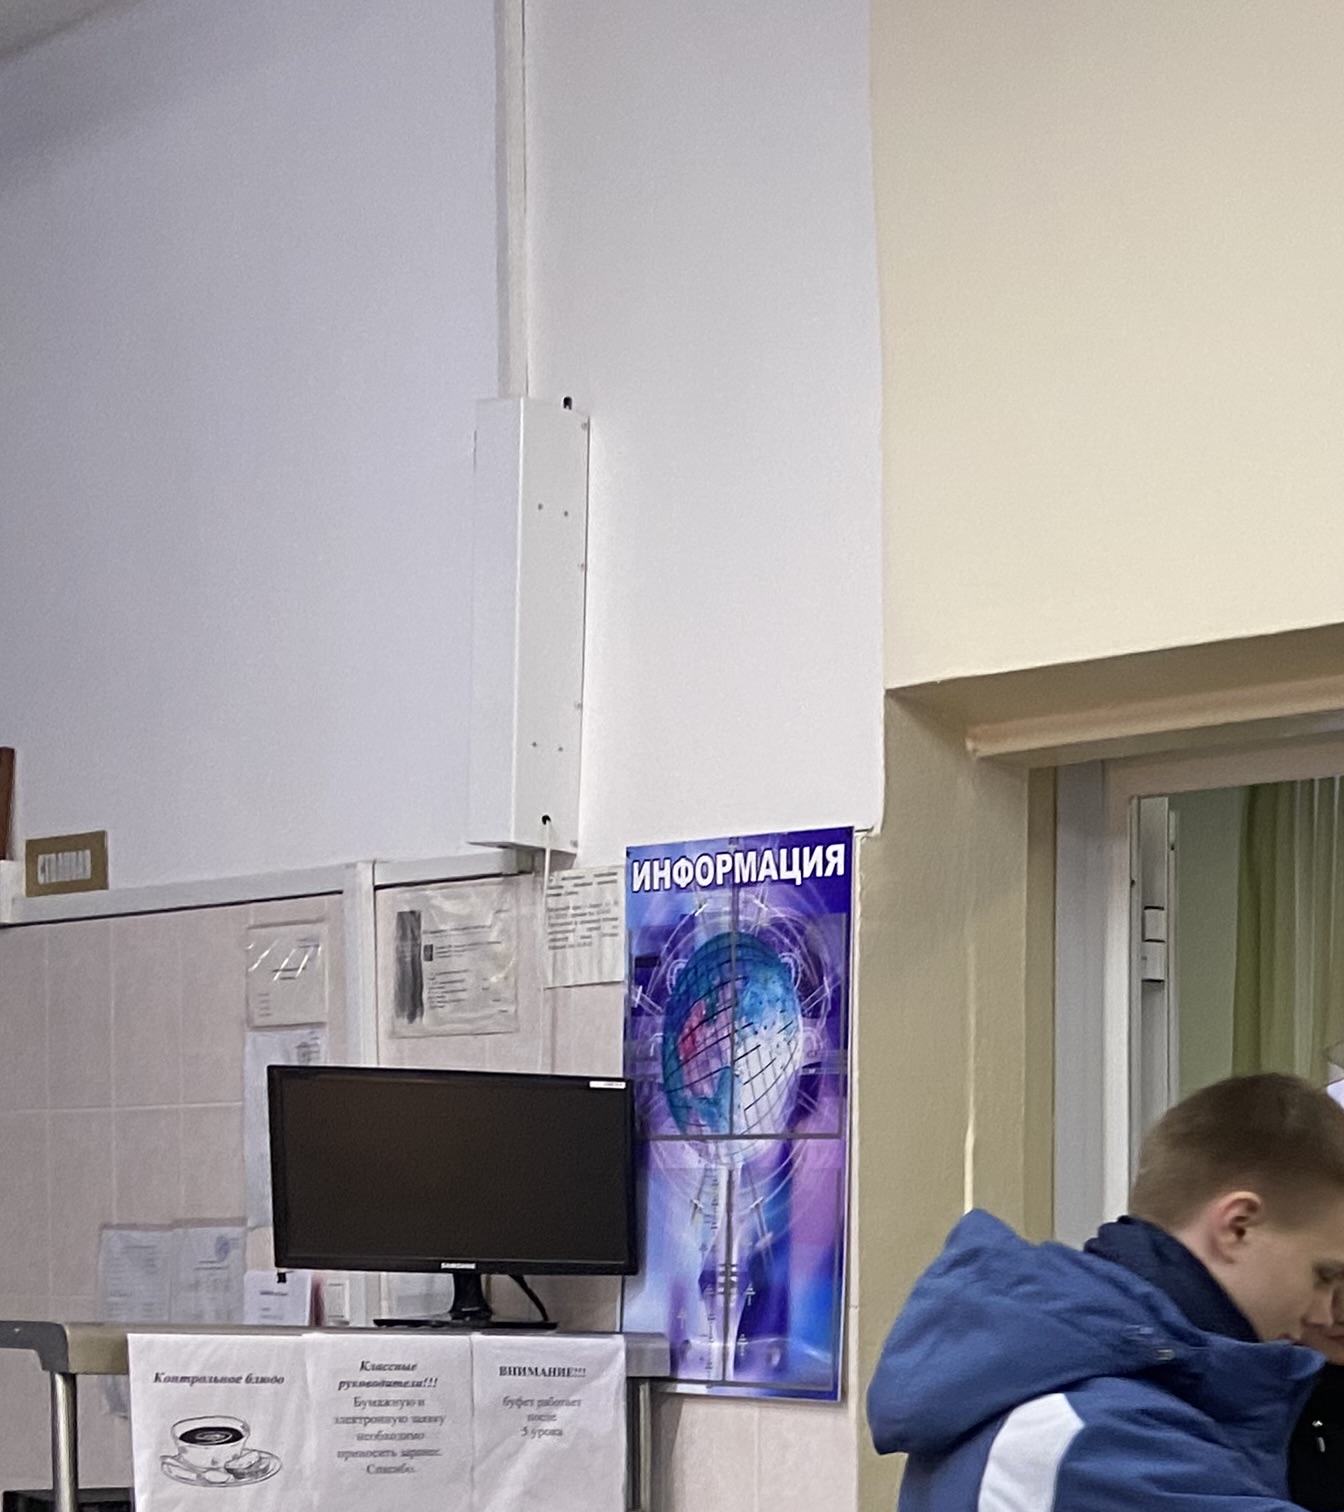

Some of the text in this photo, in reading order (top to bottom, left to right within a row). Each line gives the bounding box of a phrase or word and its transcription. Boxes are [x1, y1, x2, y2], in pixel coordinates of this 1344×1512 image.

[632, 843, 845, 893] ИНФОРМАЦИЯ
[359, 1360, 418, 1372] Классные
[499, 1366, 587, 1378] ВНИМАНИЕ!!!
[153, 1371, 285, 1387] Контрольное блюдо
[338, 1377, 438, 1391] руководители!!!
[353, 1396, 416, 1410] Бумажную
[502, 1395, 582, 1409] буфет работает
[334, 1415, 409, 1427] электронную
[356, 1430, 425, 1441] необходимо
[521, 1426, 563, 1440] 5 урока
